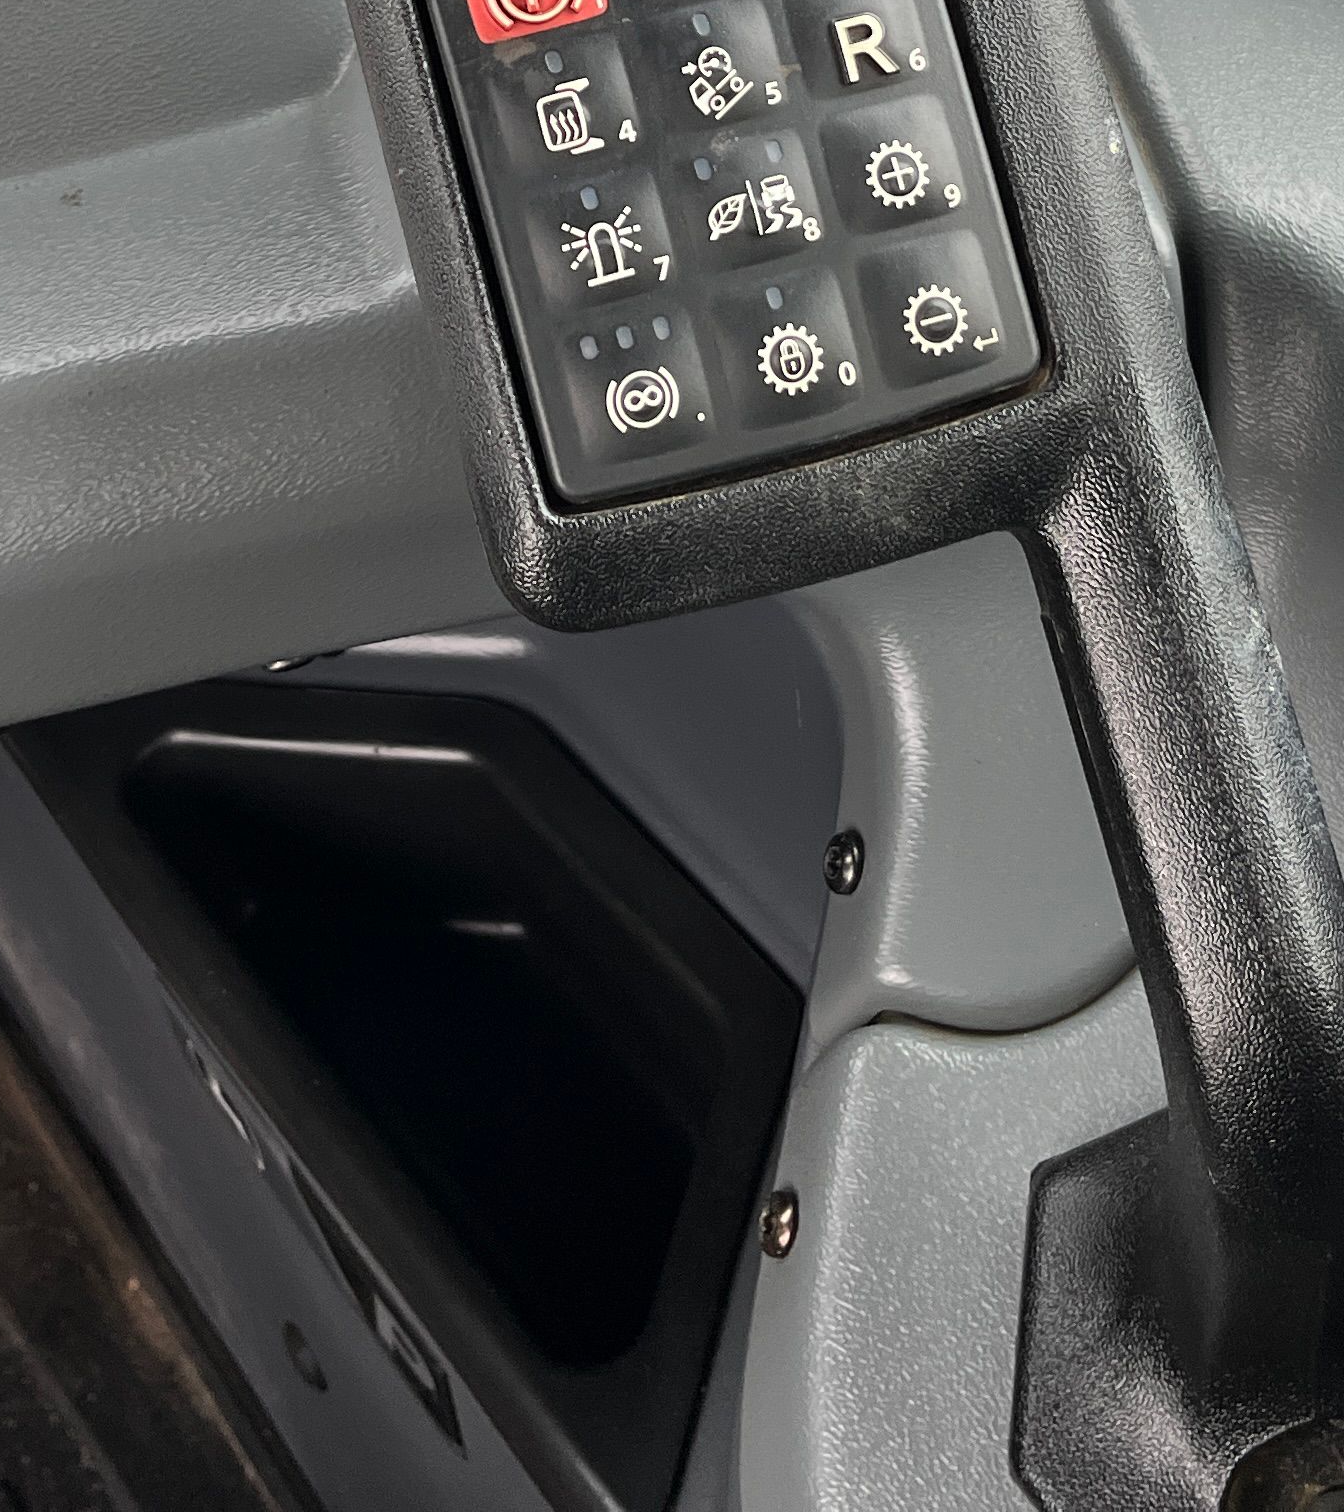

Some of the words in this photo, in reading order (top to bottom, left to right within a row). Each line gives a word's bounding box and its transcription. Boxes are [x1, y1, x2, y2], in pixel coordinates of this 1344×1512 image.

[832, 13, 901, 84] R
[908, 47, 928, 72] 6
[764, 81, 783, 105] 5
[618, 118, 638, 143] 4
[943, 183, 961, 209] 9
[802, 216, 821, 242] 8
[653, 254, 670, 282] 7
[837, 360, 857, 386] 0
